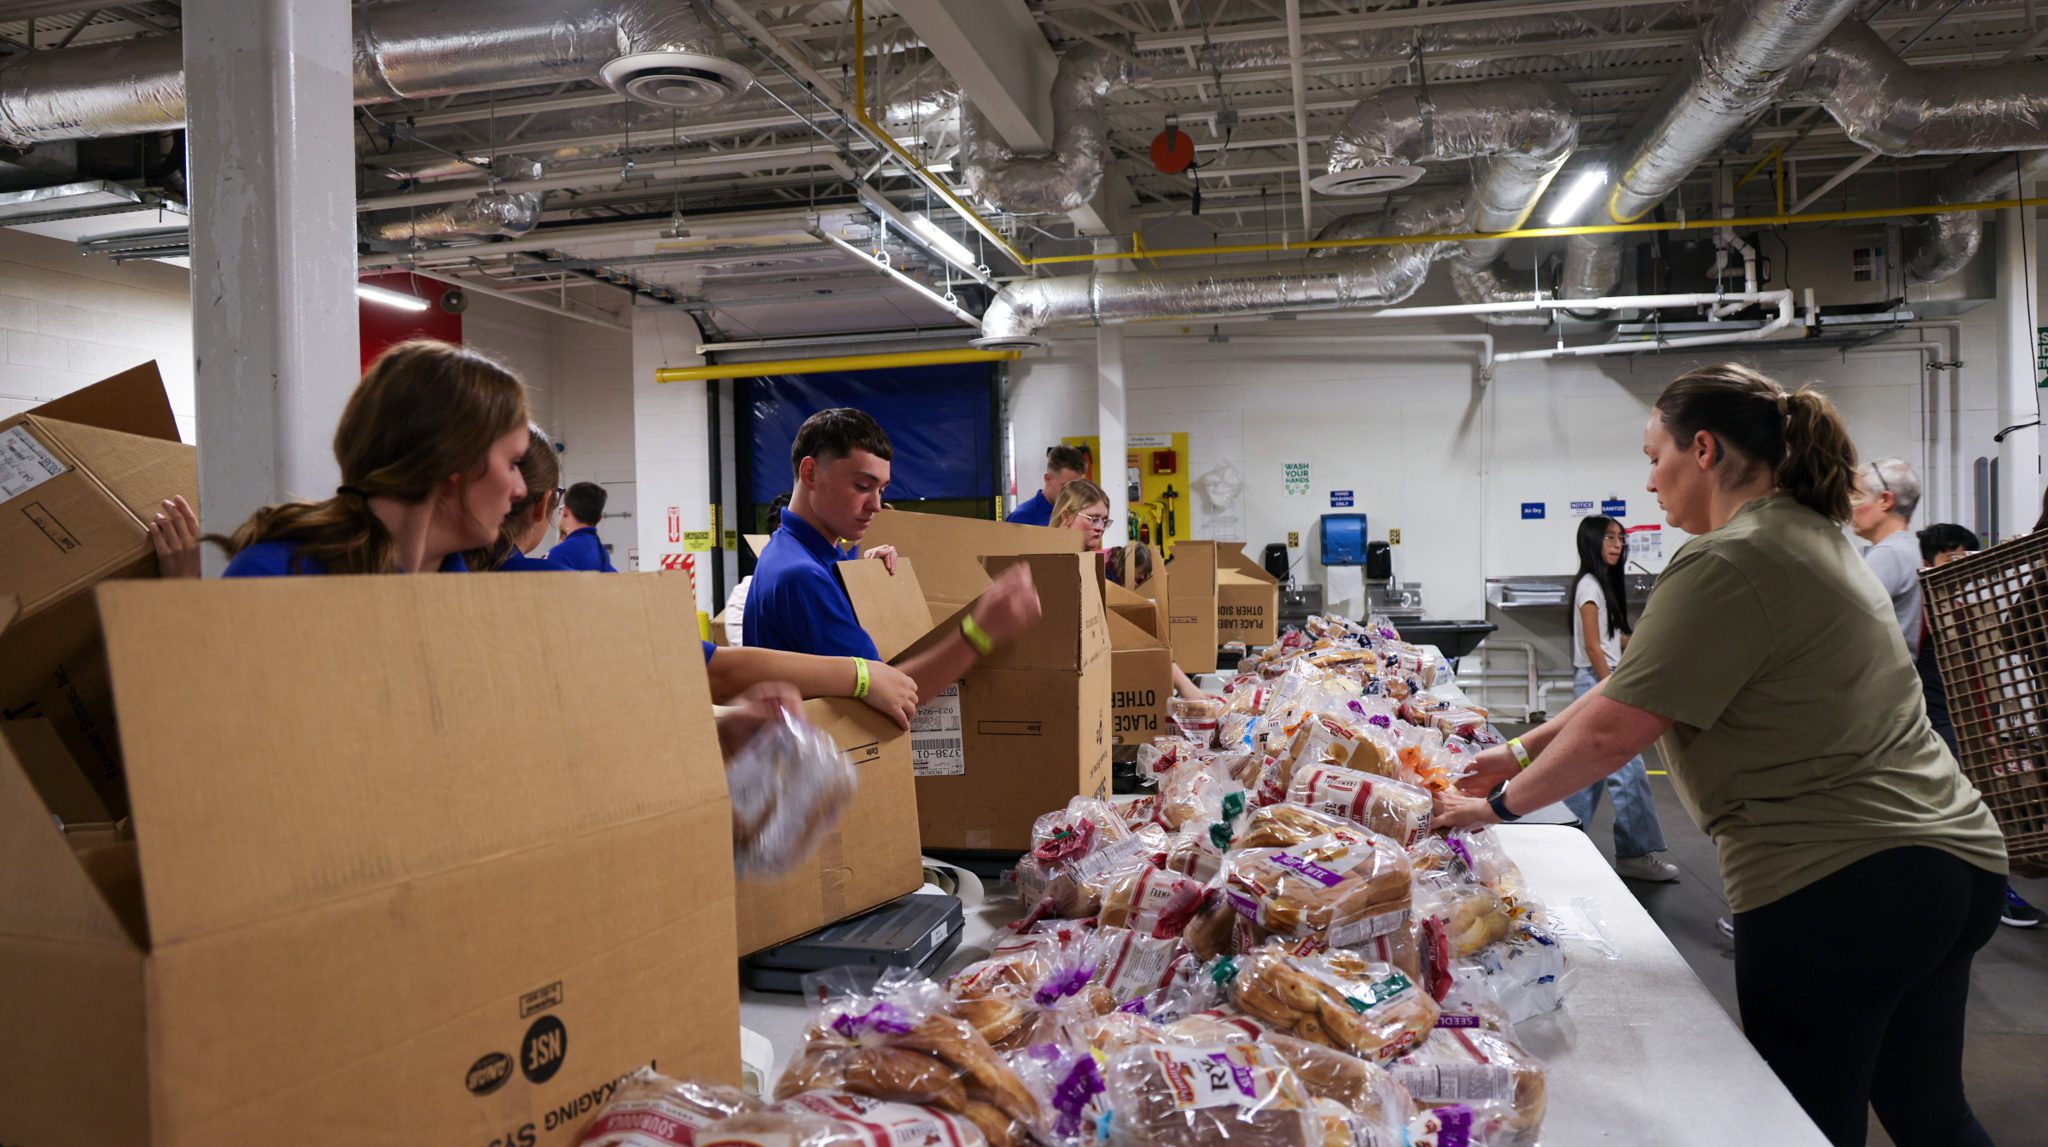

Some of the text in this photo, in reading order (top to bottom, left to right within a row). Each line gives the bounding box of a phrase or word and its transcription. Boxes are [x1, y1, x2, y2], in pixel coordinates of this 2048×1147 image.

[1236, 606, 1263, 615] OTHER
[1240, 619, 1264, 628] PLACE
[1114, 714, 1157, 732] PLACE
[917, 748, 961, 758] 3738-01
[528, 1028, 561, 1071] NSF
